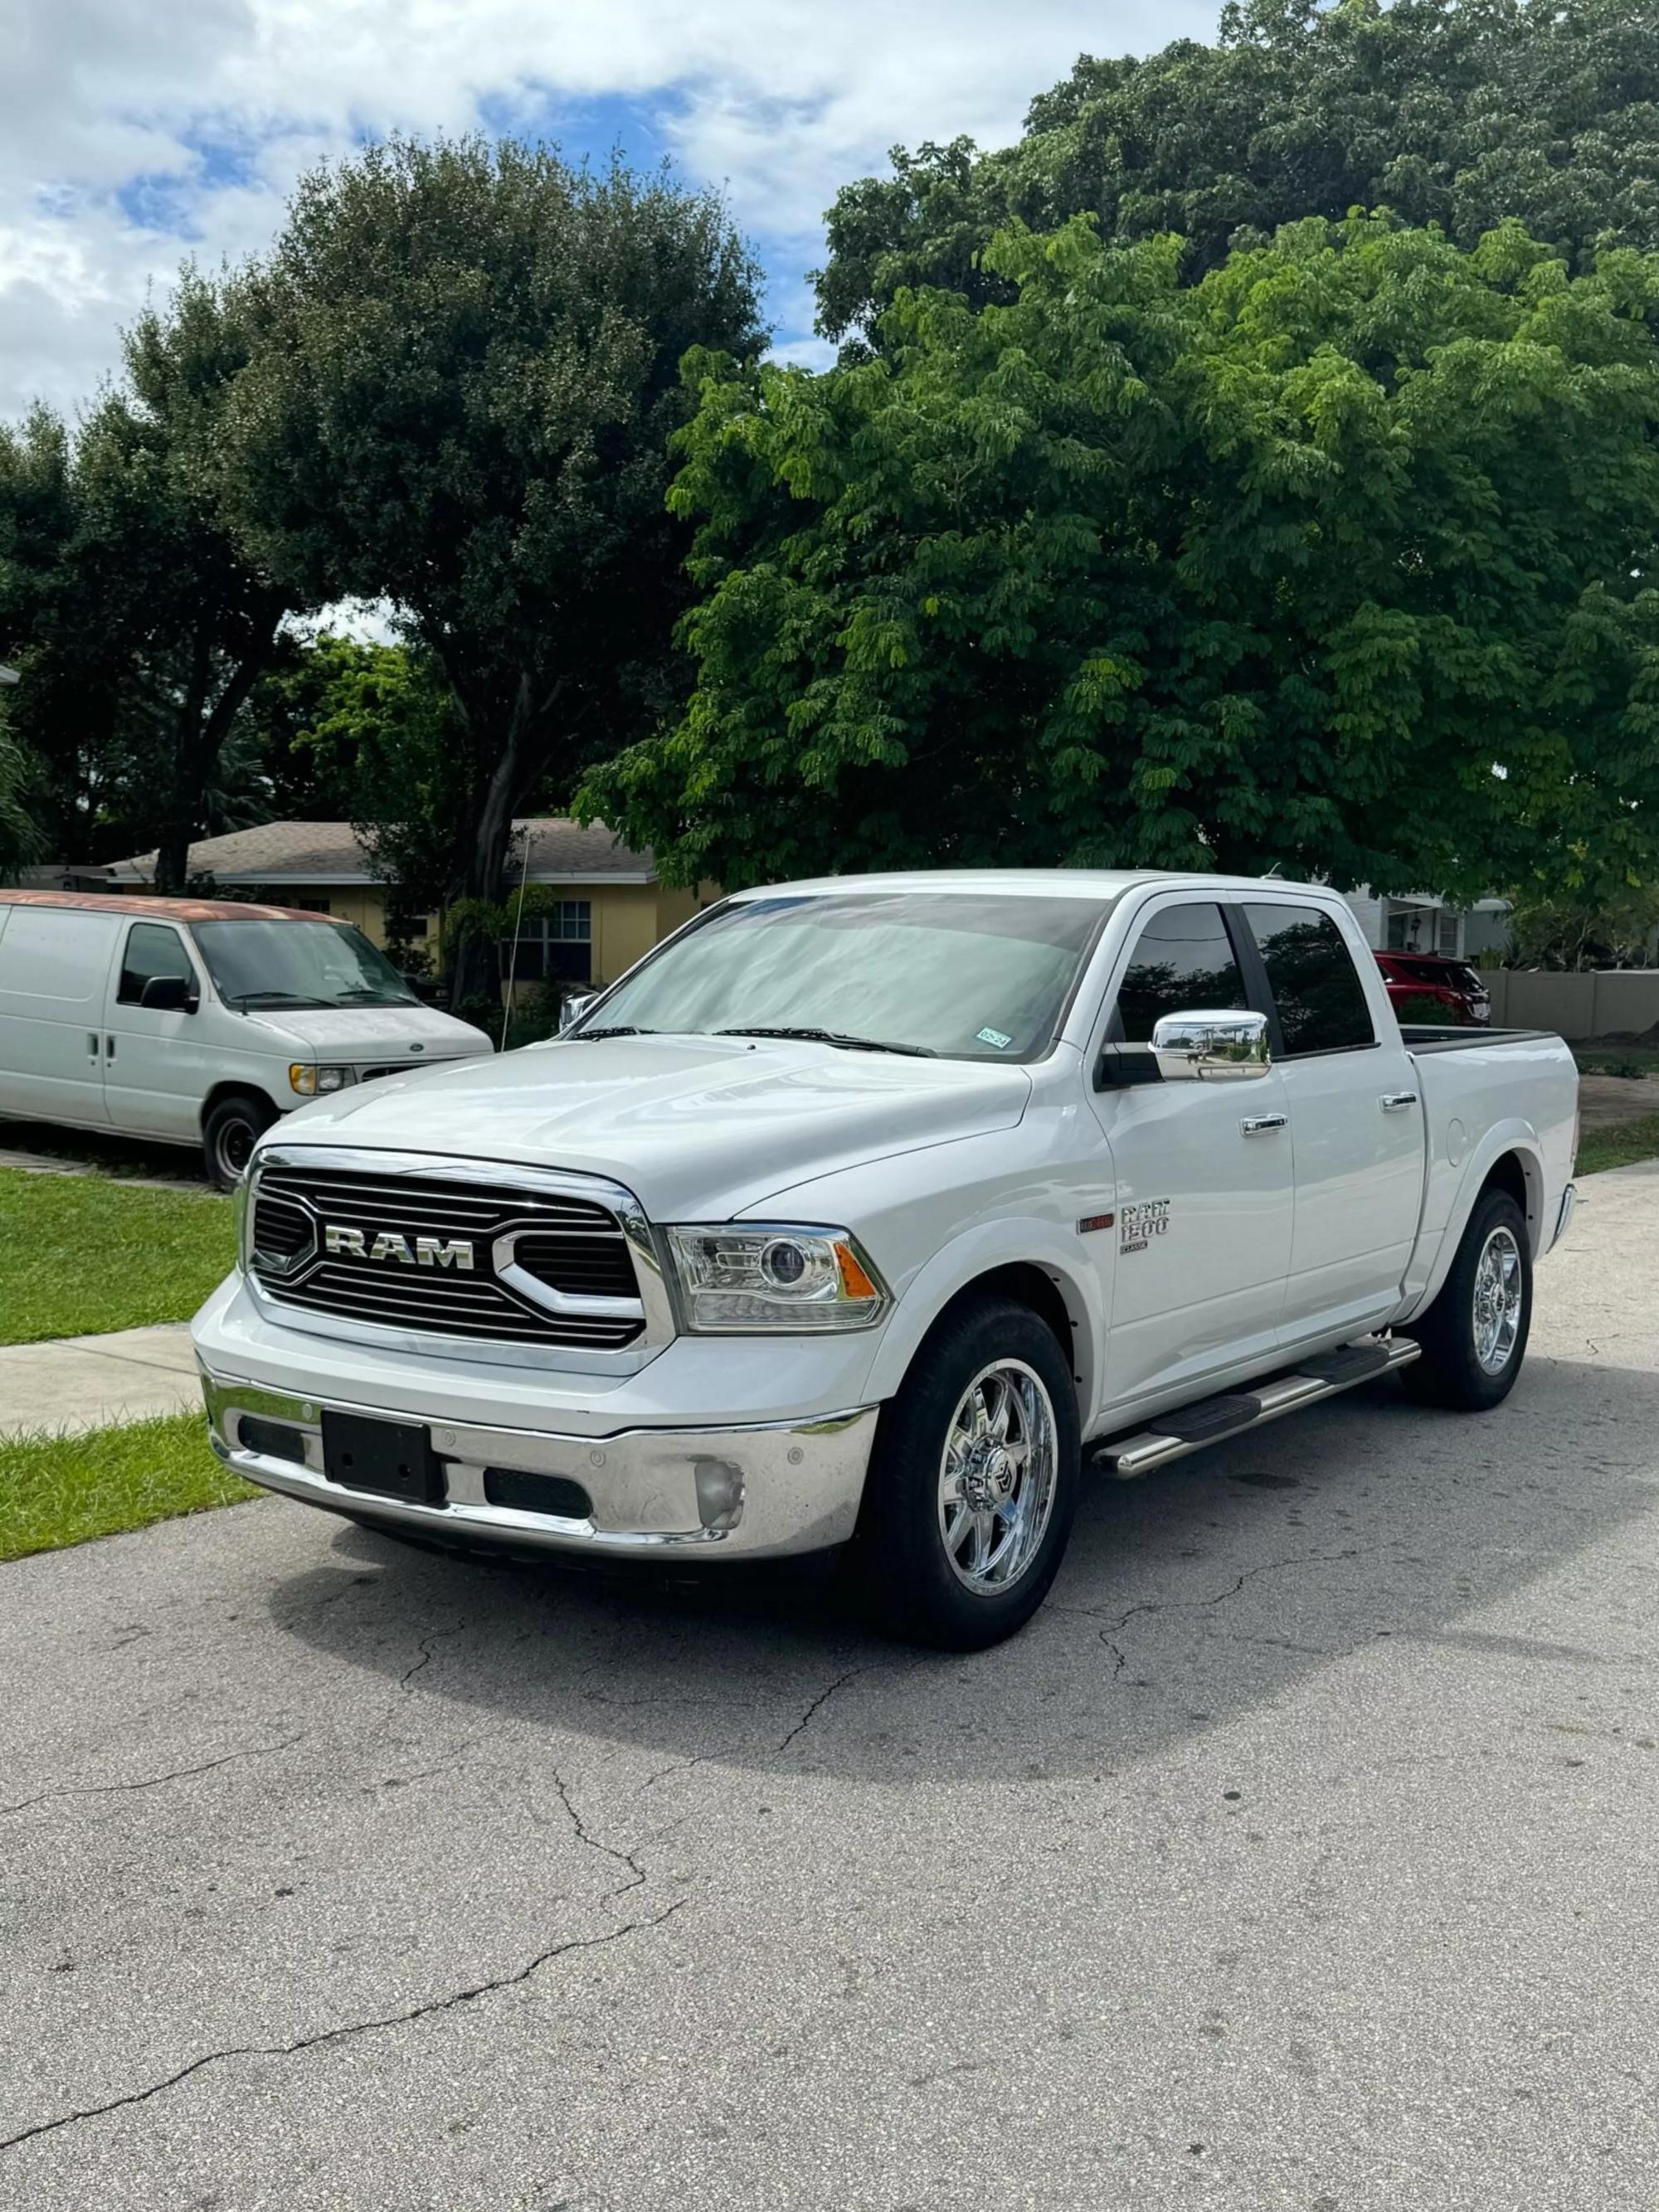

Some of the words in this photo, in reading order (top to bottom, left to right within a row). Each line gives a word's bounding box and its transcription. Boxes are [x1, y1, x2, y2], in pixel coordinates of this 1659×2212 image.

[1121, 1198, 1170, 1225] RAM
[1121, 1216, 1170, 1243] 1500
[325, 1225, 474, 1270] RAM
